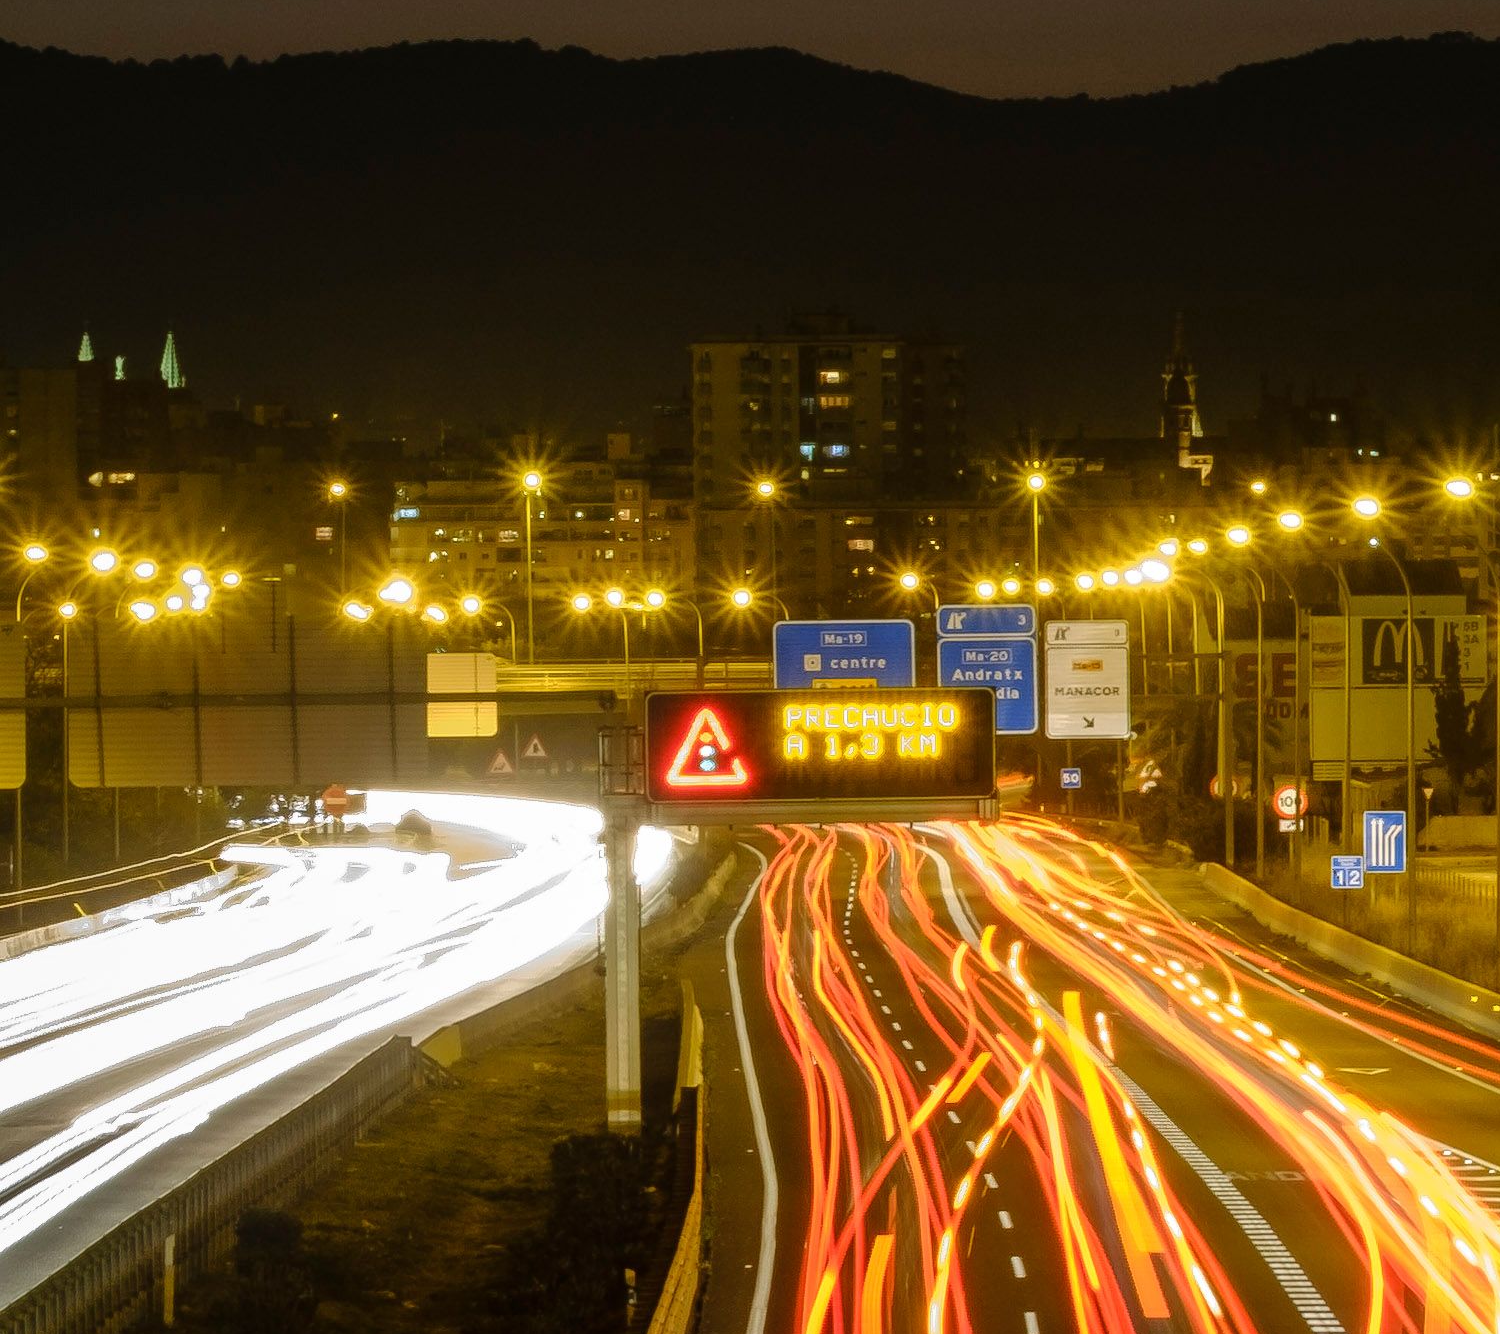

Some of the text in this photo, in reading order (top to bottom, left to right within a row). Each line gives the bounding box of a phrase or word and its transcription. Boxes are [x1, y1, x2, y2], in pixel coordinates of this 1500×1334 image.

[1017, 615, 1026, 625] 3
[823, 633, 864, 645] Ma-19
[965, 651, 1009, 662] Ma-20
[829, 657, 887, 669] centre
[952, 668, 1023, 682] Andratx
[1054, 686, 1121, 697] MANACOR
[785, 735, 804, 757] A
[900, 734, 938, 756] KM
